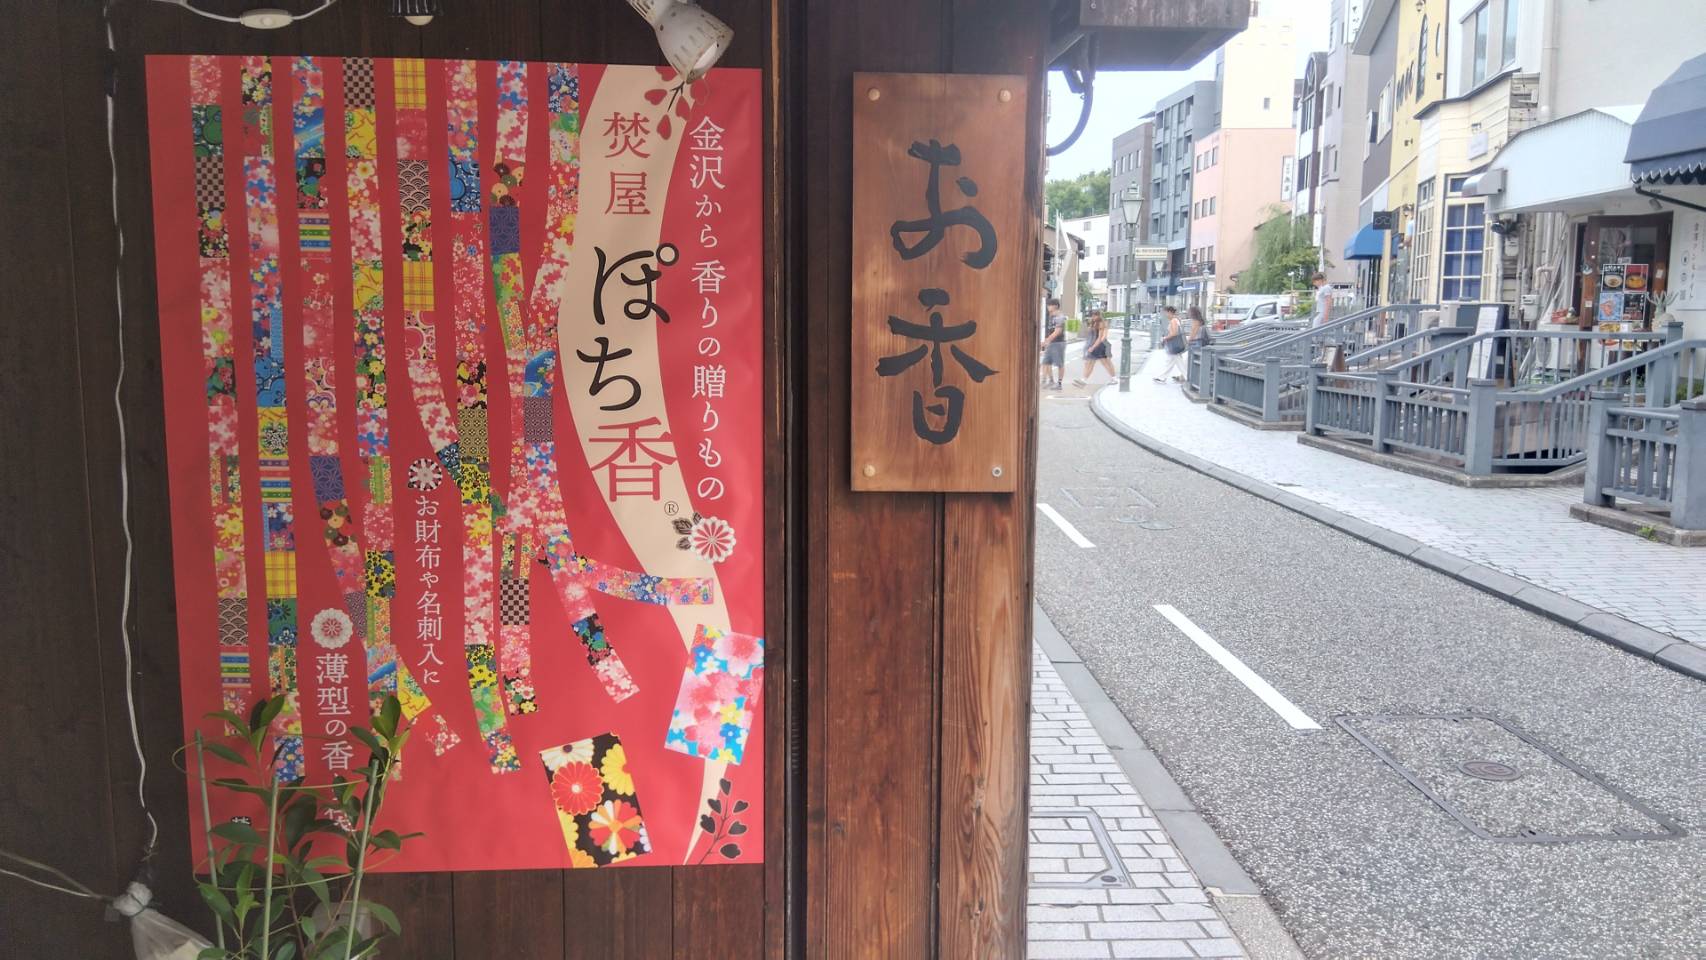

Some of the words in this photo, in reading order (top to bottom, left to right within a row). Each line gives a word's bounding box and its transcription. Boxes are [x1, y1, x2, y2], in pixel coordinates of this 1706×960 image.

[689, 116, 726, 500] 金沢から香りの贈りもの
[876, 139, 1000, 444] お香
[415, 495, 444, 684] お財布や名刺入に
